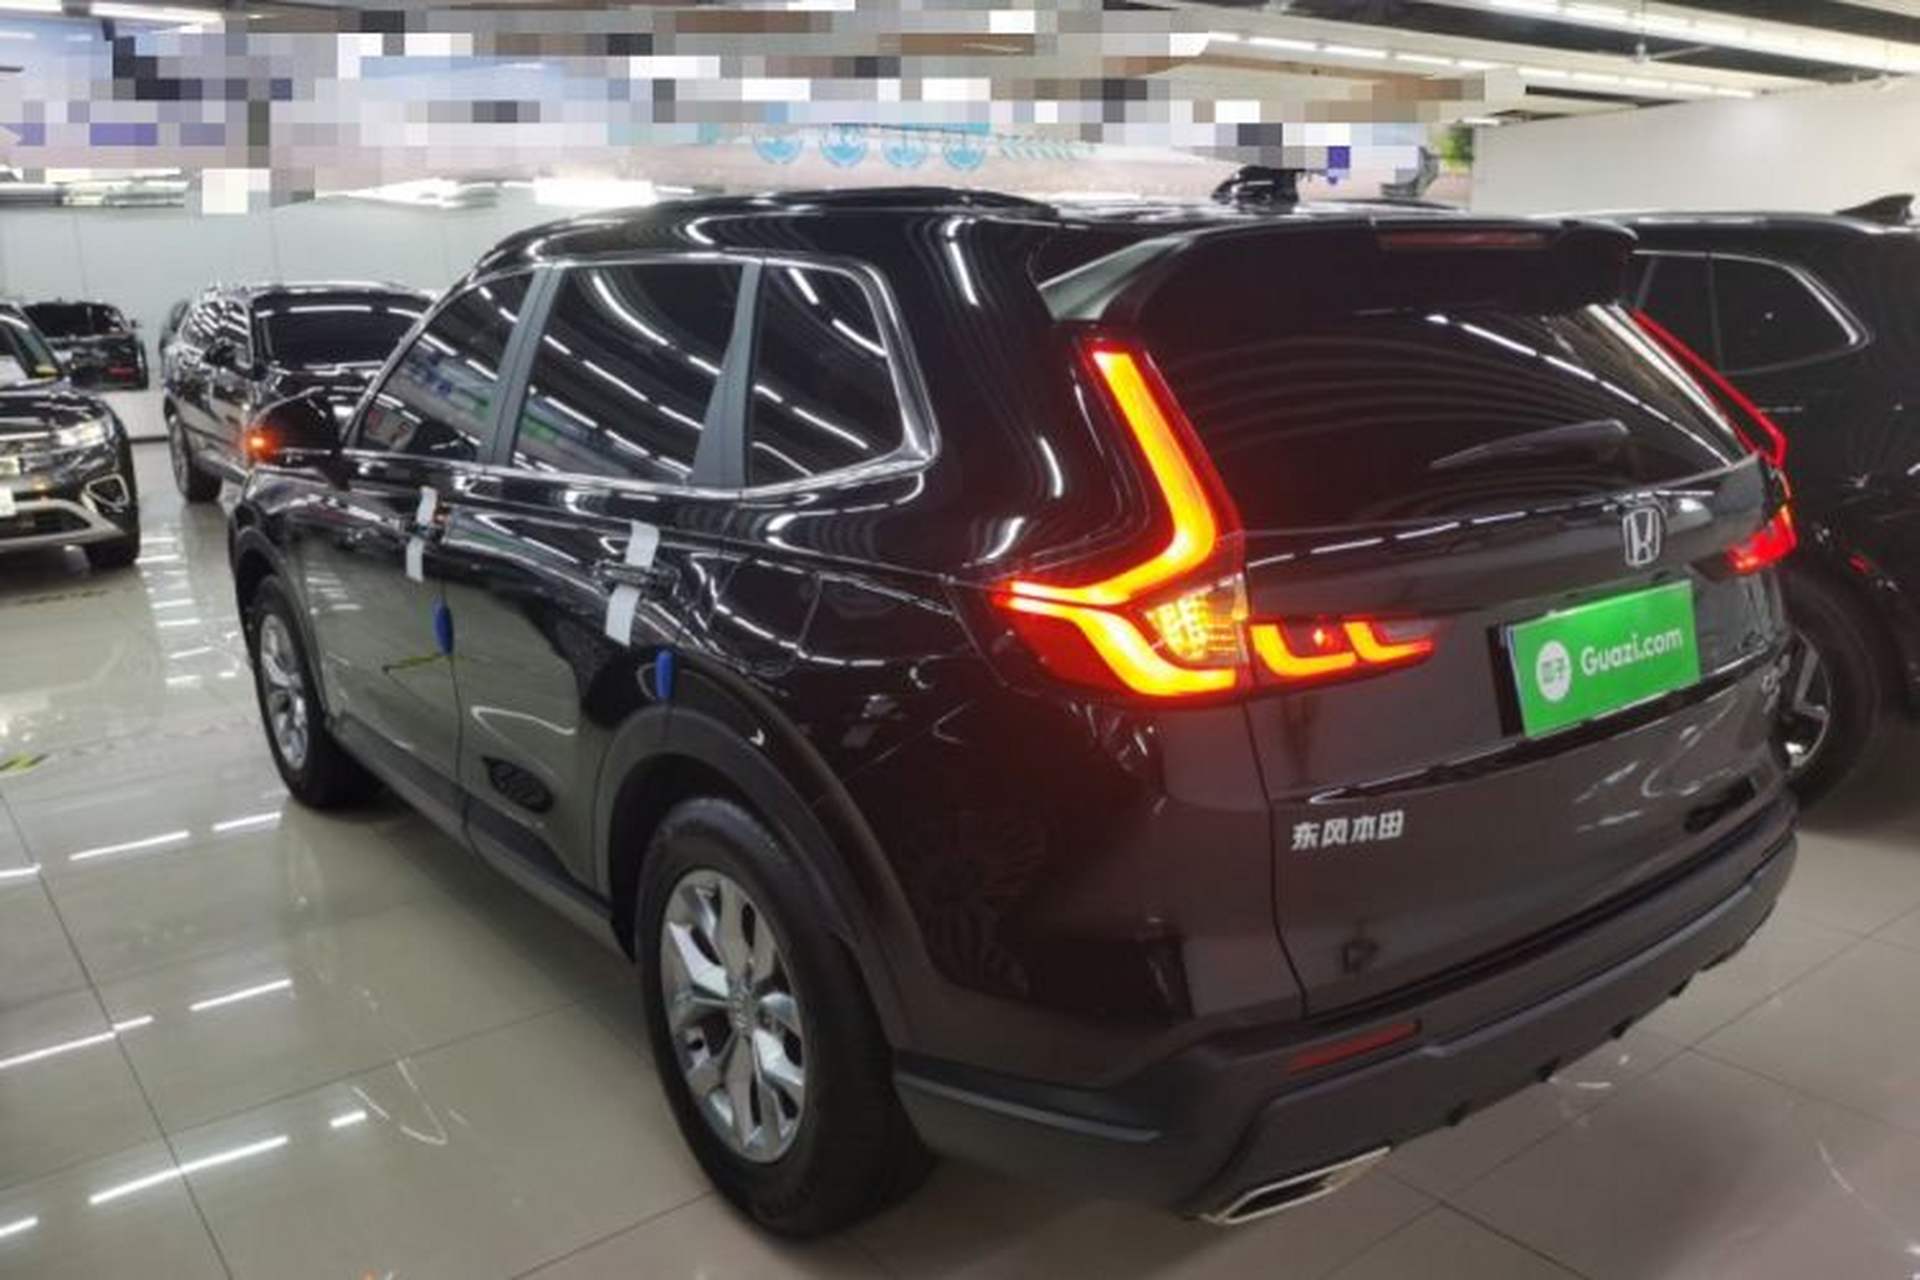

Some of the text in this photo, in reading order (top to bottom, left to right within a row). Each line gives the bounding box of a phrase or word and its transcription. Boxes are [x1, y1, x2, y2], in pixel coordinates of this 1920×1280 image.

[1581, 627, 1683, 677] Guazi.com
[1291, 809, 1404, 851] 东风本田
